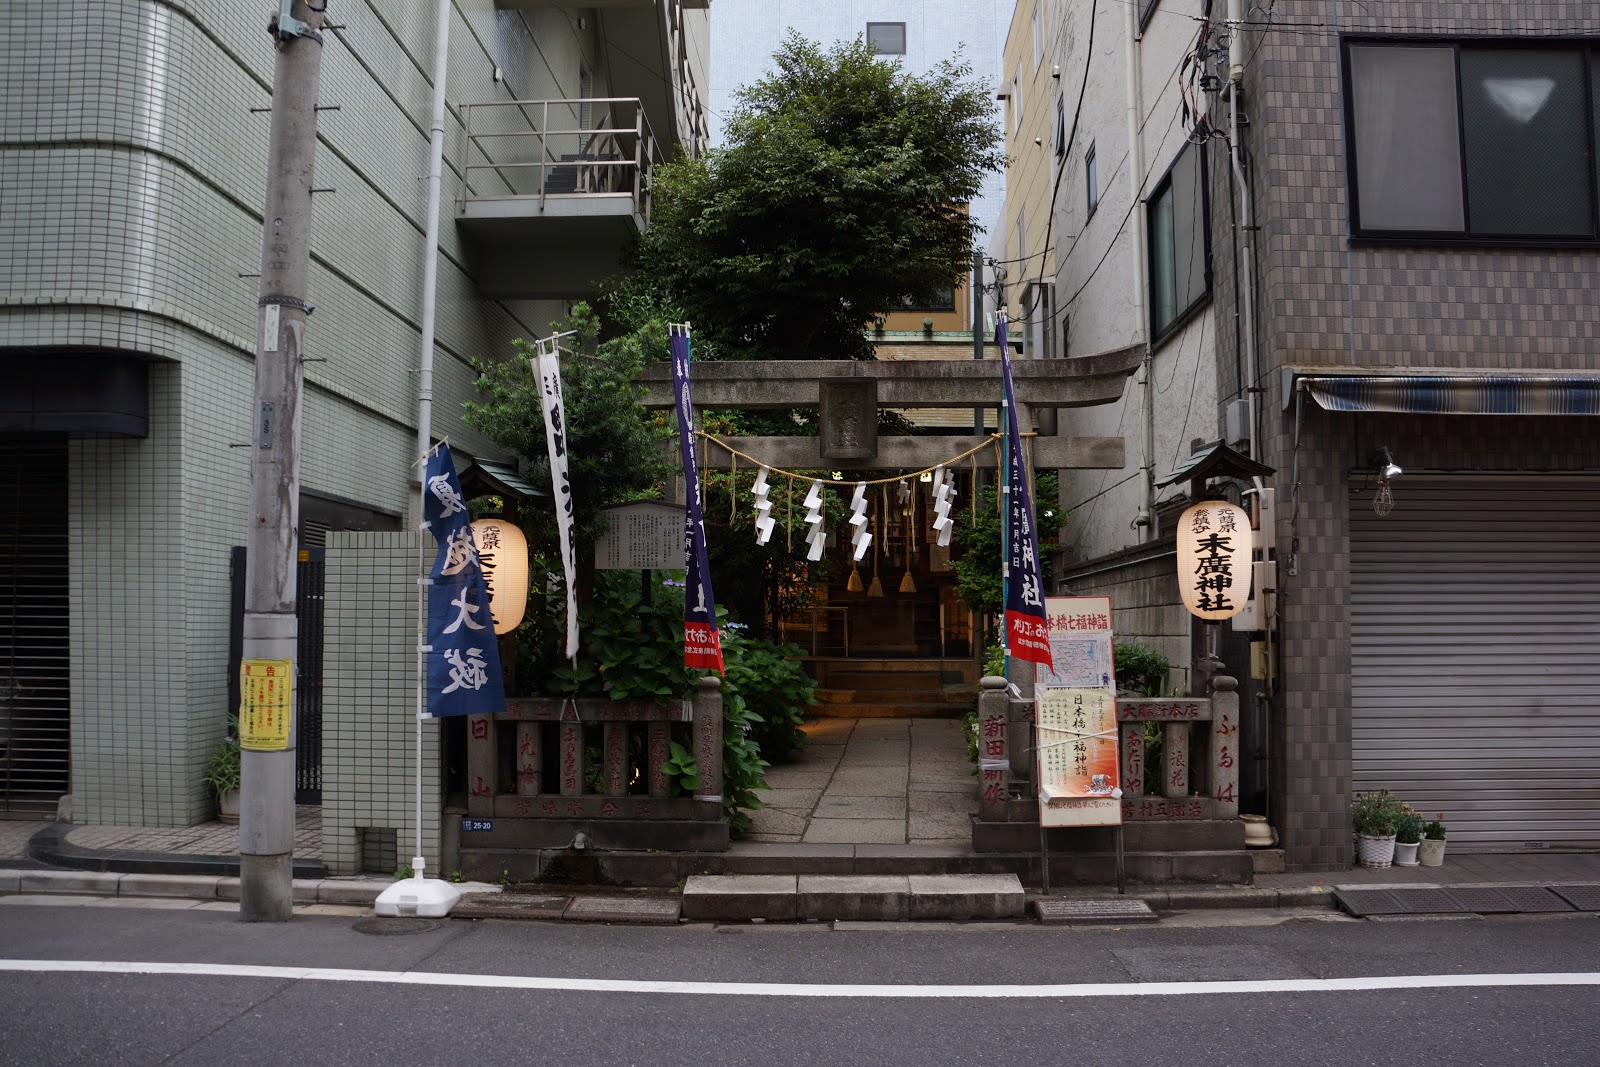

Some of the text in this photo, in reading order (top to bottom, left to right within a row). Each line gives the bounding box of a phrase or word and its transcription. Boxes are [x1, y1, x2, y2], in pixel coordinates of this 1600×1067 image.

[1194, 533, 1236, 611] 末廣神社
[1047, 614, 1108, 631] 本橋七福神詣
[1126, 730, 1142, 792] あたりや
[473, 822, 491, 830] 25-20
